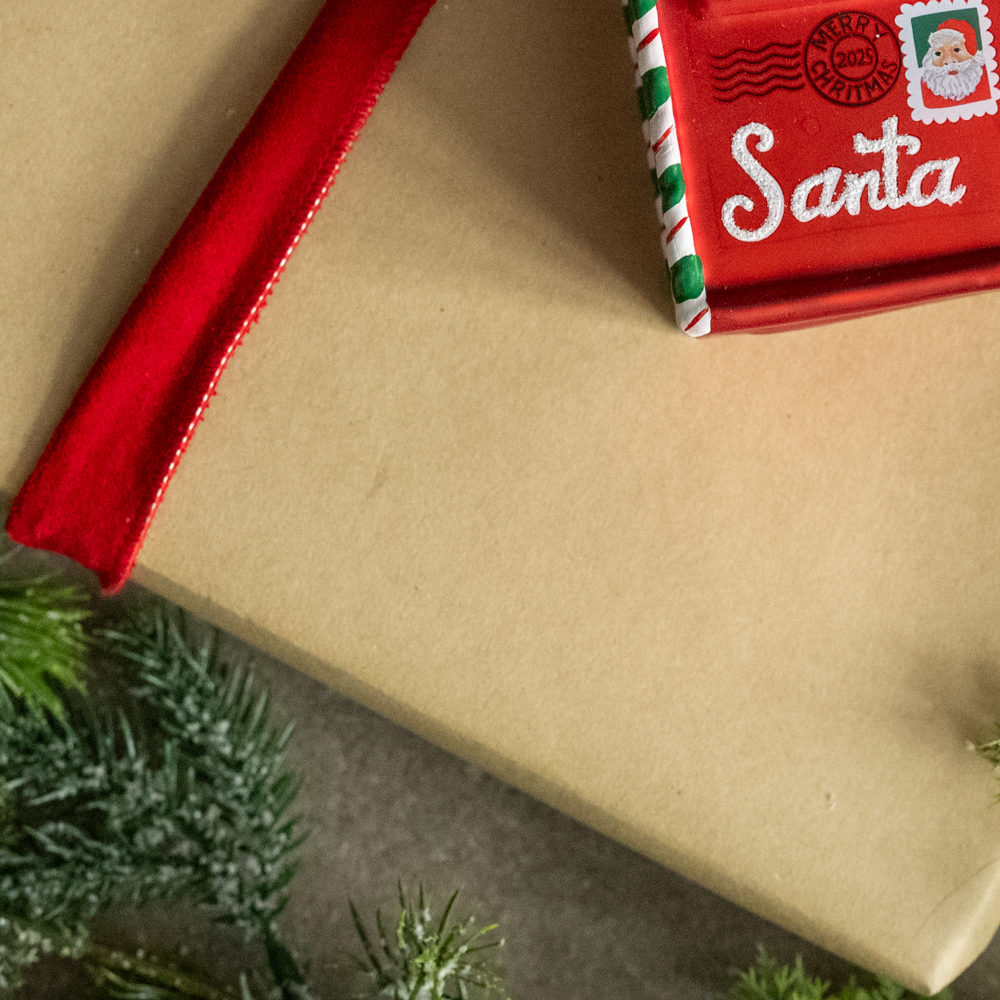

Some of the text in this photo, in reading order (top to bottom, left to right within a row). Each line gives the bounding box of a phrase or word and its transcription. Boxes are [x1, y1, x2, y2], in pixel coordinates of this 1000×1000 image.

[810, 14, 888, 52] MERRY
[836, 47, 873, 68] 2025
[721, 115, 967, 242] Santa
